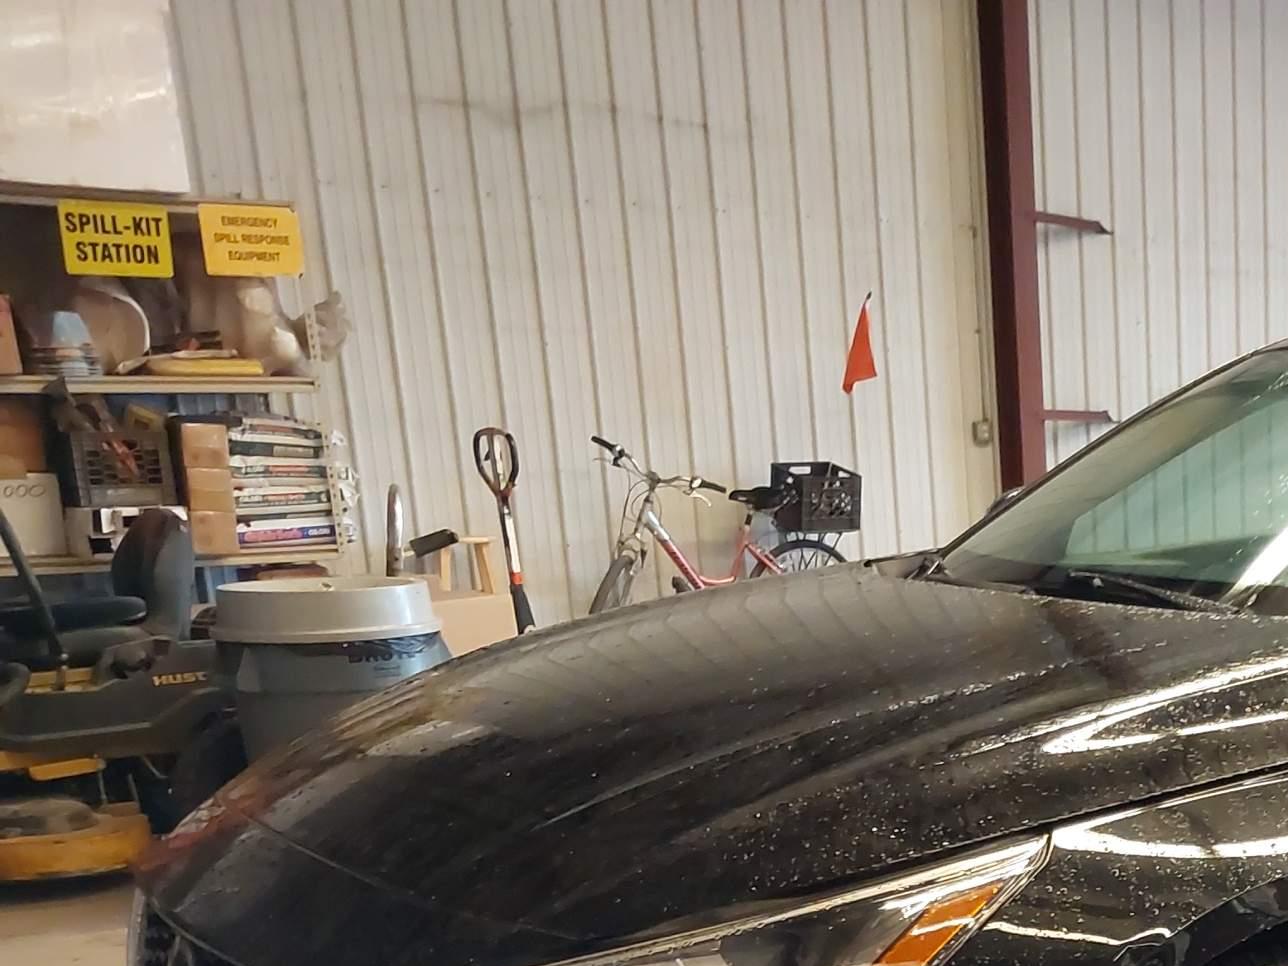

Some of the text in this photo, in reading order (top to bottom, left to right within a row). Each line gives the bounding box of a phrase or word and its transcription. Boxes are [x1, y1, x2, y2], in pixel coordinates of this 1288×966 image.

[65, 211, 162, 237] SPILL-KIT
[221, 215, 278, 229] EMERGENCY
[75, 241, 160, 264] STATION
